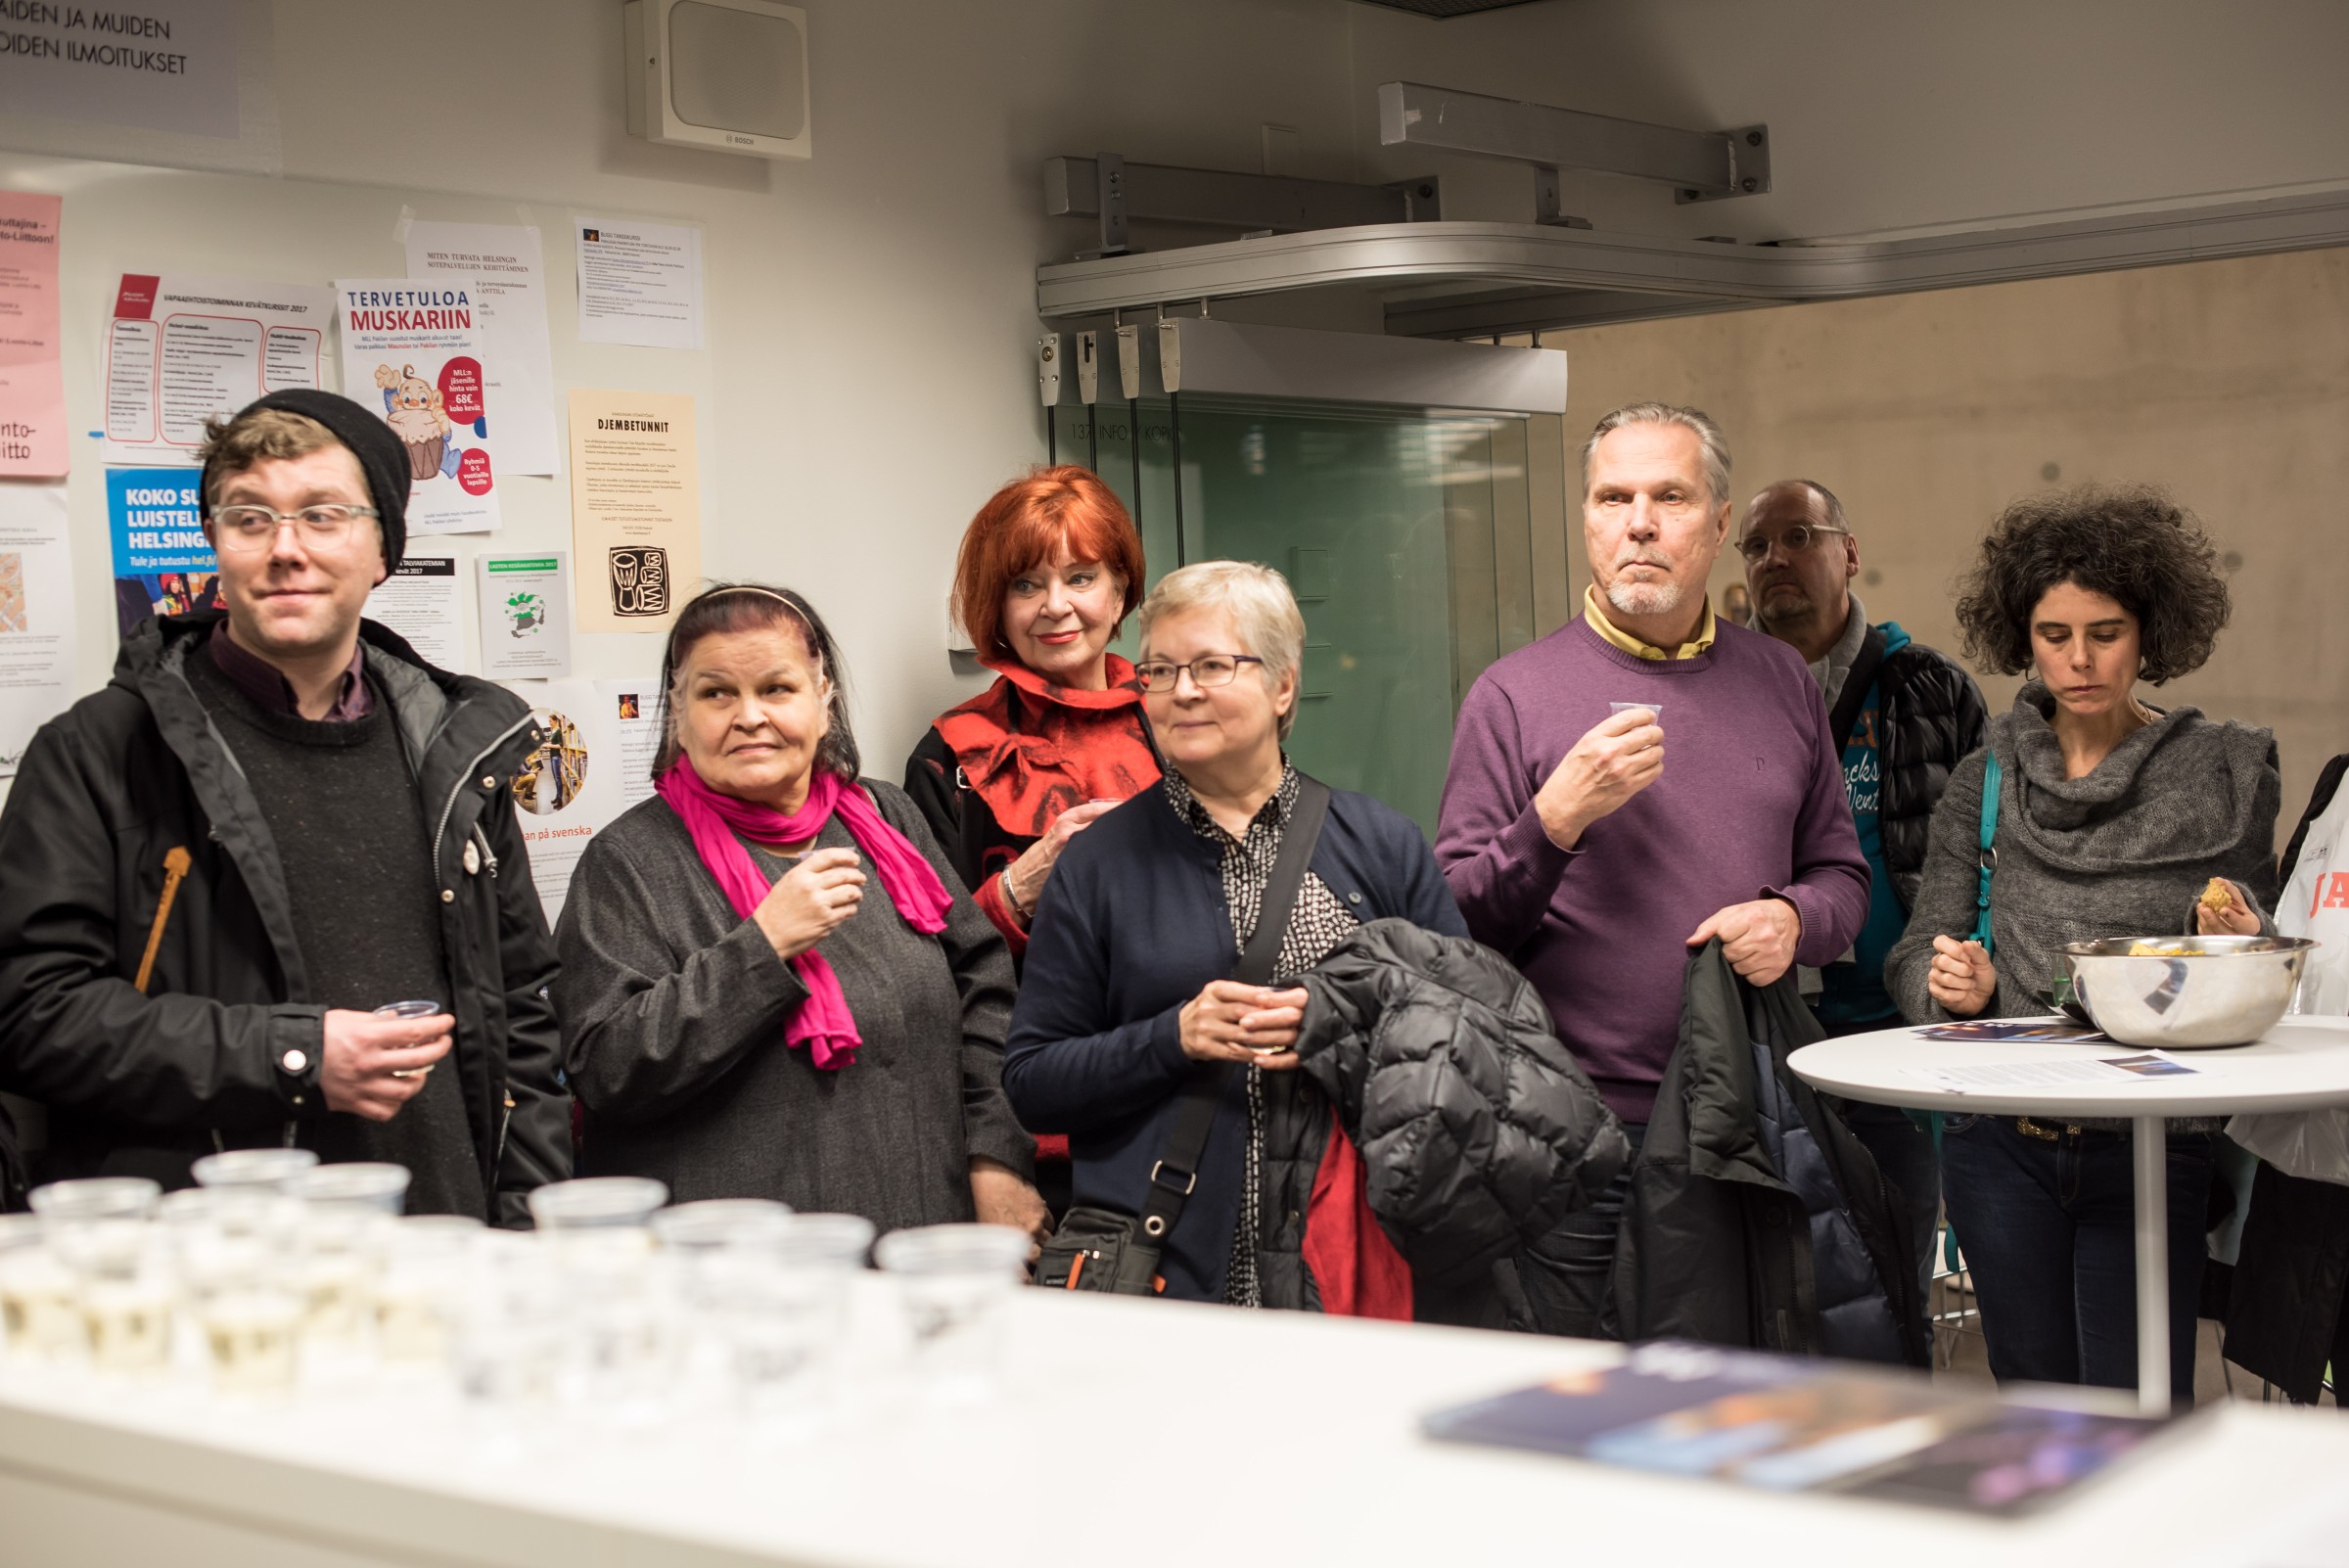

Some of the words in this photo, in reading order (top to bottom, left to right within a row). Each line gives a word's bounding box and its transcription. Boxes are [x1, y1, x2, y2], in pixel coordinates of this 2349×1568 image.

[64, 7, 86, 28] JA
[92, 12, 170, 40] MUIDEN
[67, 40, 187, 75] ILMOITUKSET
[734, 136, 755, 146] BOSCH
[427, 252, 449, 260] MITEN
[451, 253, 481, 262] TURVATA
[483, 254, 517, 263] HELSINGIN
[427, 261, 481, 270] SOTEPALVELUJEN
[484, 263, 529, 273] KEHITTÄMINEN
[163, 295, 244, 307] VAPAAEHTOISTOIMINNAN
[245, 300, 290, 311] KEVÄTKURSSIT
[290, 304, 308, 313] 2017
[347, 291, 469, 307] TERVETULOA
[350, 309, 471, 331] MUSKARIIN
[455, 393, 473, 404] 68€
[597, 418, 669, 433] DJEMBETUNNIT
[1099, 425, 1128, 440] INFO
[125, 488, 177, 506] KOKO
[129, 556, 148, 567] Tule
[148, 555, 158, 568] ja
[159, 556, 191, 566] tutustu
[523, 832, 536, 841] an
[537, 827, 550, 842] på
[551, 825, 593, 839] svenska
[2309, 871, 2349, 919] JA
